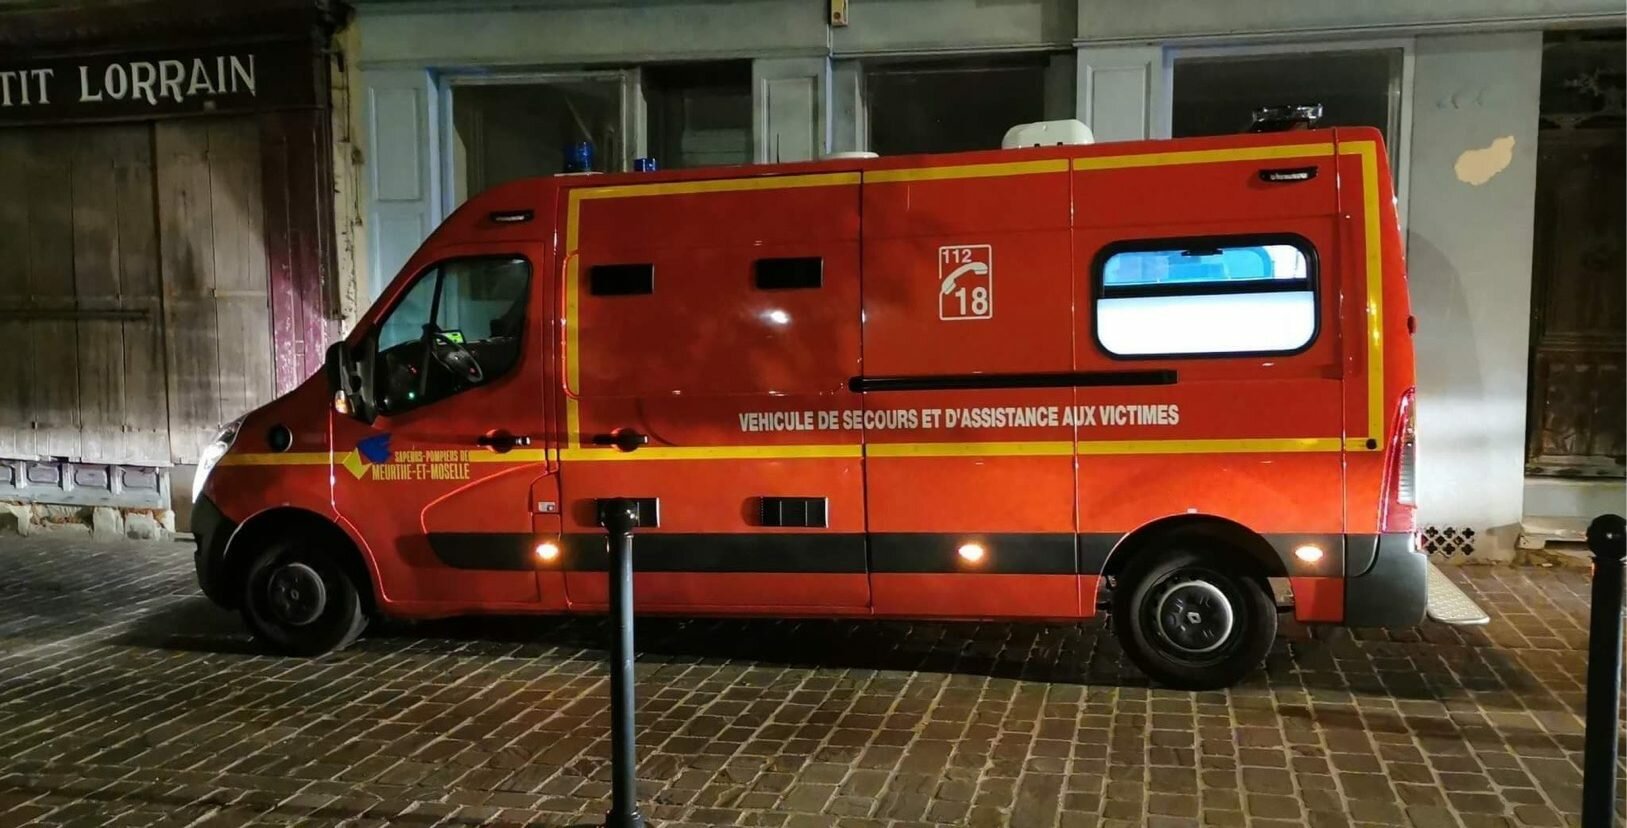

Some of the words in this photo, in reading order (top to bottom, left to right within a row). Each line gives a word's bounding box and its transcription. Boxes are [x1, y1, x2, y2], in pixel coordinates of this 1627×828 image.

[78, 54, 256, 105] LORRAIN
[942, 249, 972, 264] 112
[955, 287, 988, 315] 18
[739, 411, 814, 432] VEHICULE
[818, 410, 840, 430] DE
[843, 409, 918, 430] SECOURS
[922, 408, 941, 429] ET
[946, 406, 1059, 429] D'ASSISTANCE
[1062, 405, 1096, 426] AUX
[1099, 404, 1180, 426] VICTIMES
[372, 463, 470, 480] MEURTHE-ET-MOSELLE
